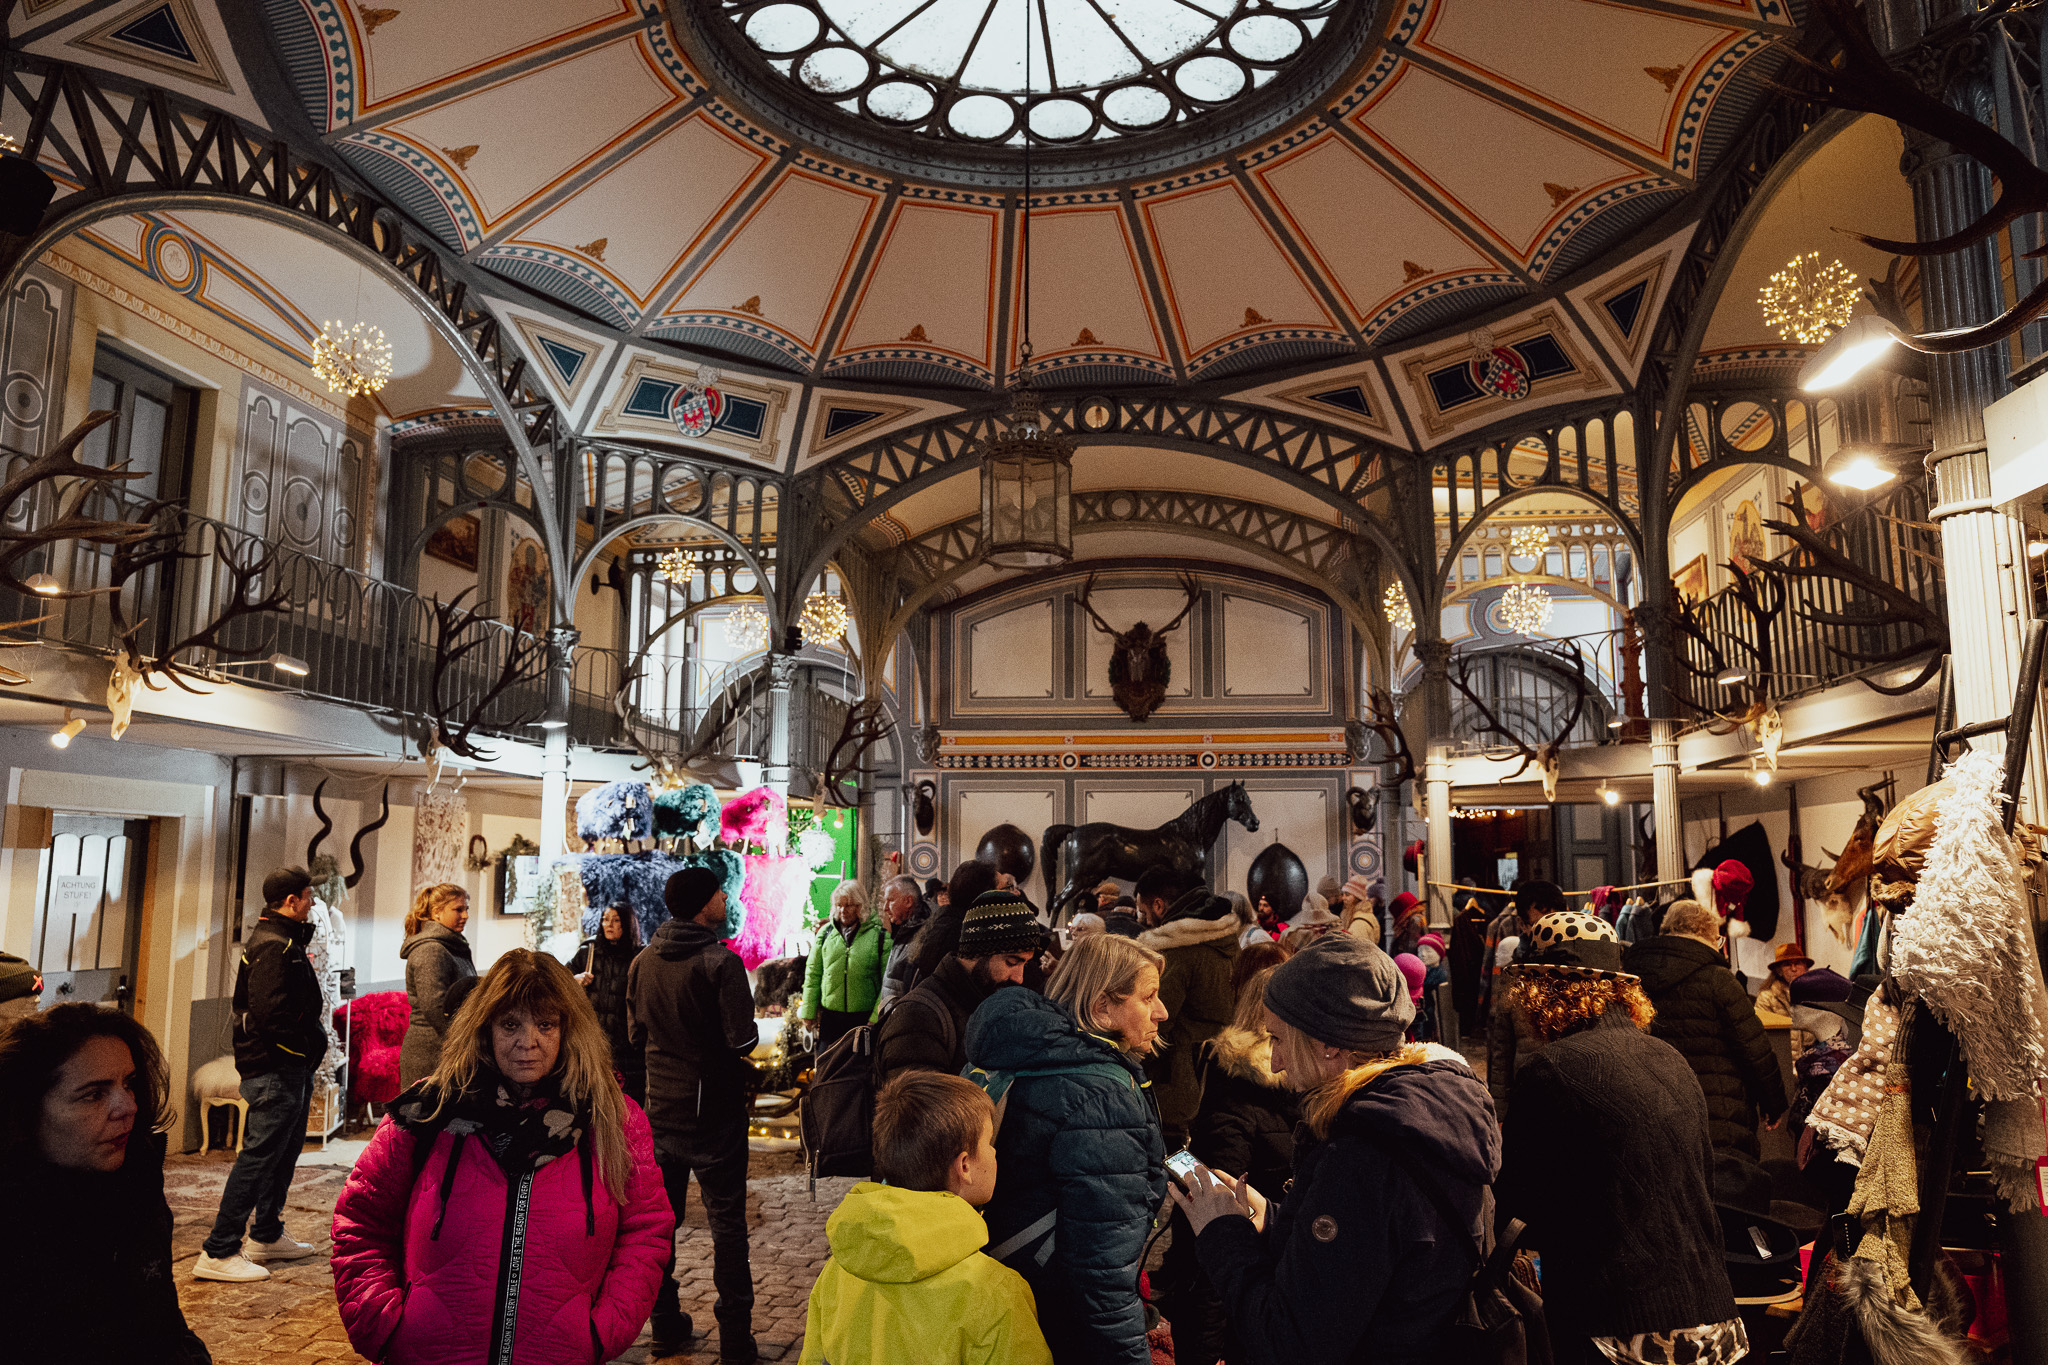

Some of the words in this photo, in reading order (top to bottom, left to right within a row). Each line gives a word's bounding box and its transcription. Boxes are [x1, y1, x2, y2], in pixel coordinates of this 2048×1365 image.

[61, 881, 96, 889] ACHTUNG
[63, 891, 92, 899] STUFE!
[520, 1181, 529, 1199] EVERY
[518, 1200, 526, 1212] FOR
[516, 1212, 525, 1235] REASON
[514, 1236, 522, 1248] THE
[512, 1256, 520, 1271] LOVE
[509, 1279, 518, 1296] SMILE
[507, 1298, 516, 1316] EVERY
[505, 1317, 514, 1330] FOR
[503, 1331, 512, 1353] REASON
